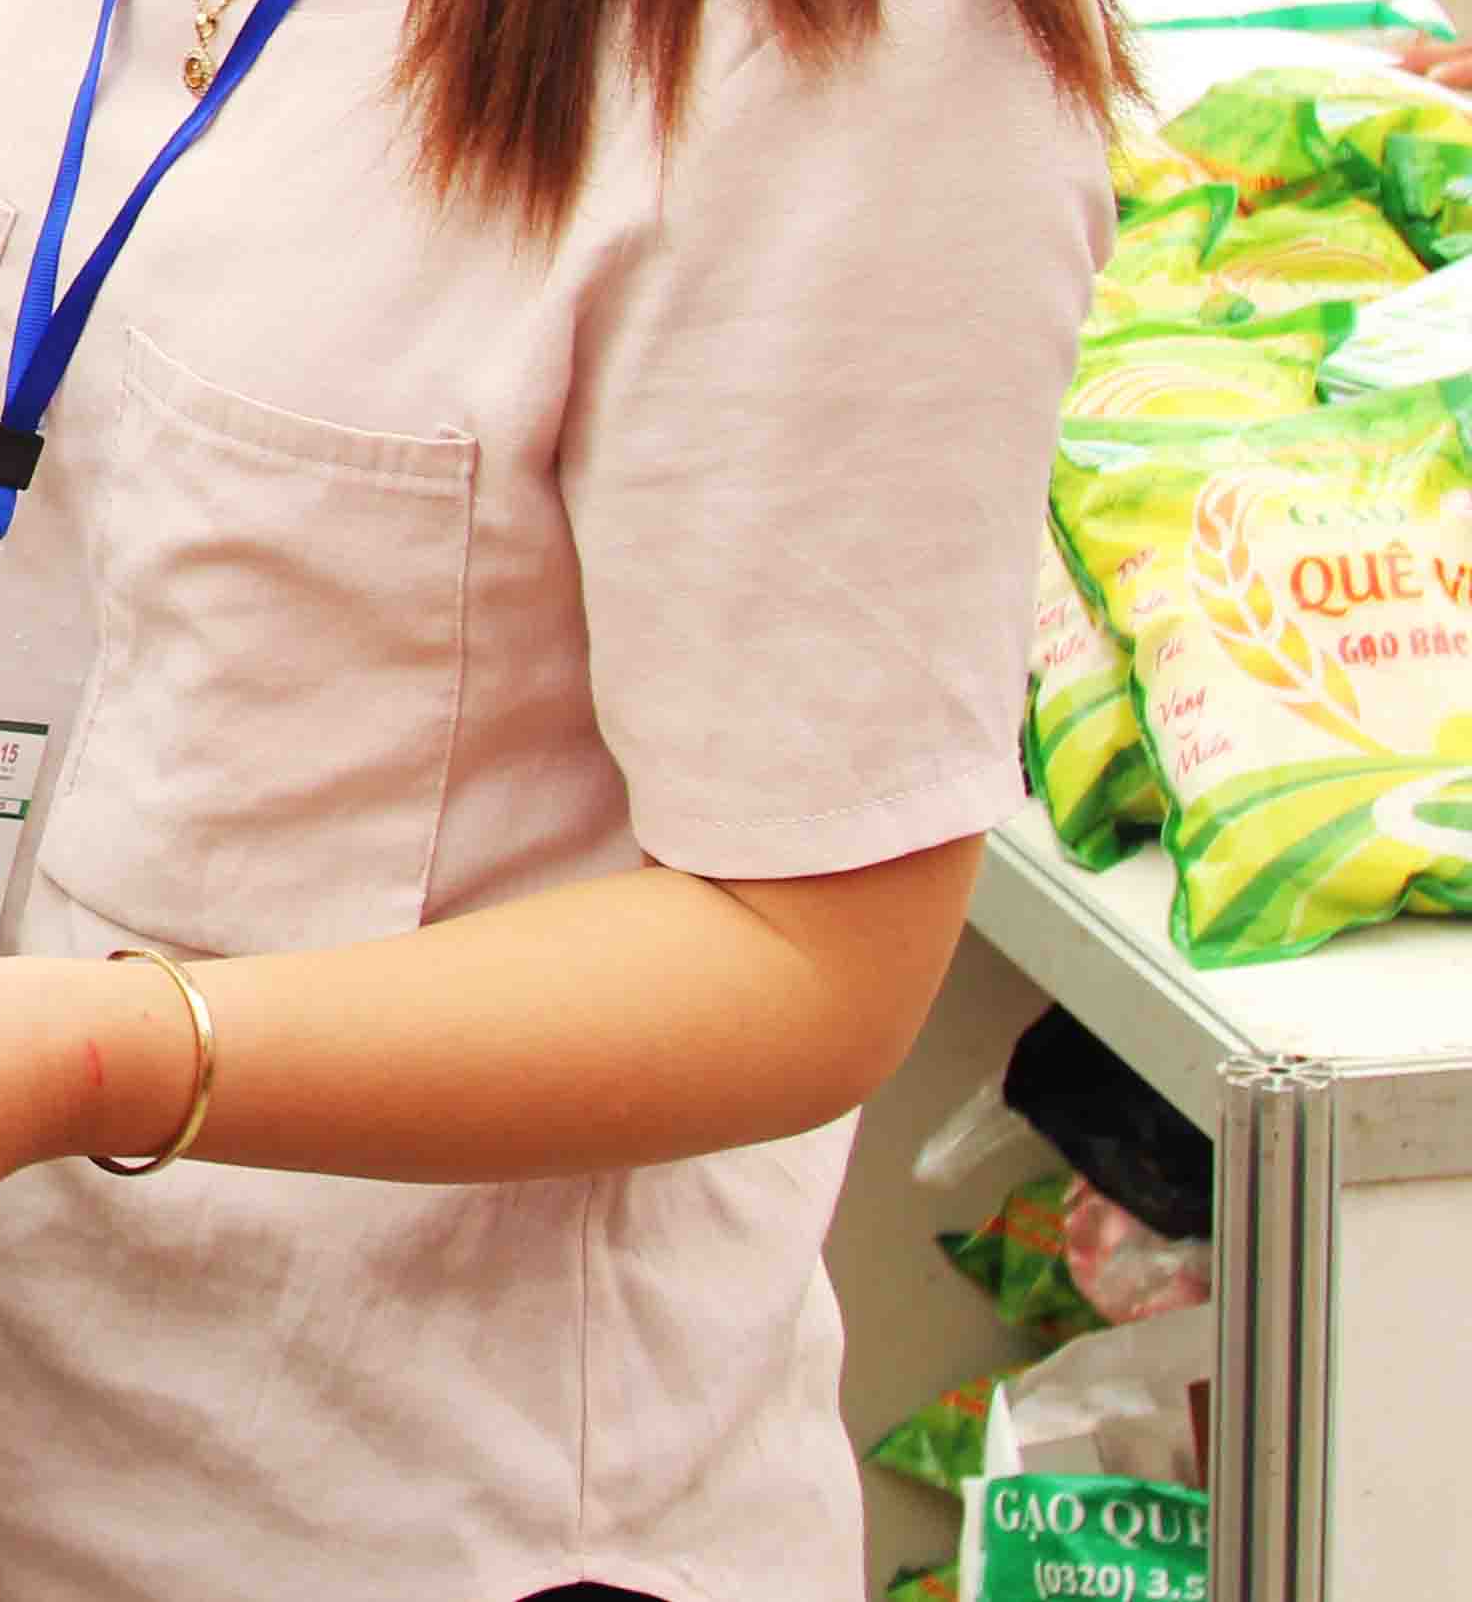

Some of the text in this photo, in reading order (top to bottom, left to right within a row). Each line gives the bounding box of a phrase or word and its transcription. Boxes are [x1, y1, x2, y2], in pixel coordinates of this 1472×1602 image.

[1290, 540, 1472, 618] QUÊ V
[994, 1488, 1085, 1542] GẠO
[1034, 1557, 1136, 1602] (0320)
